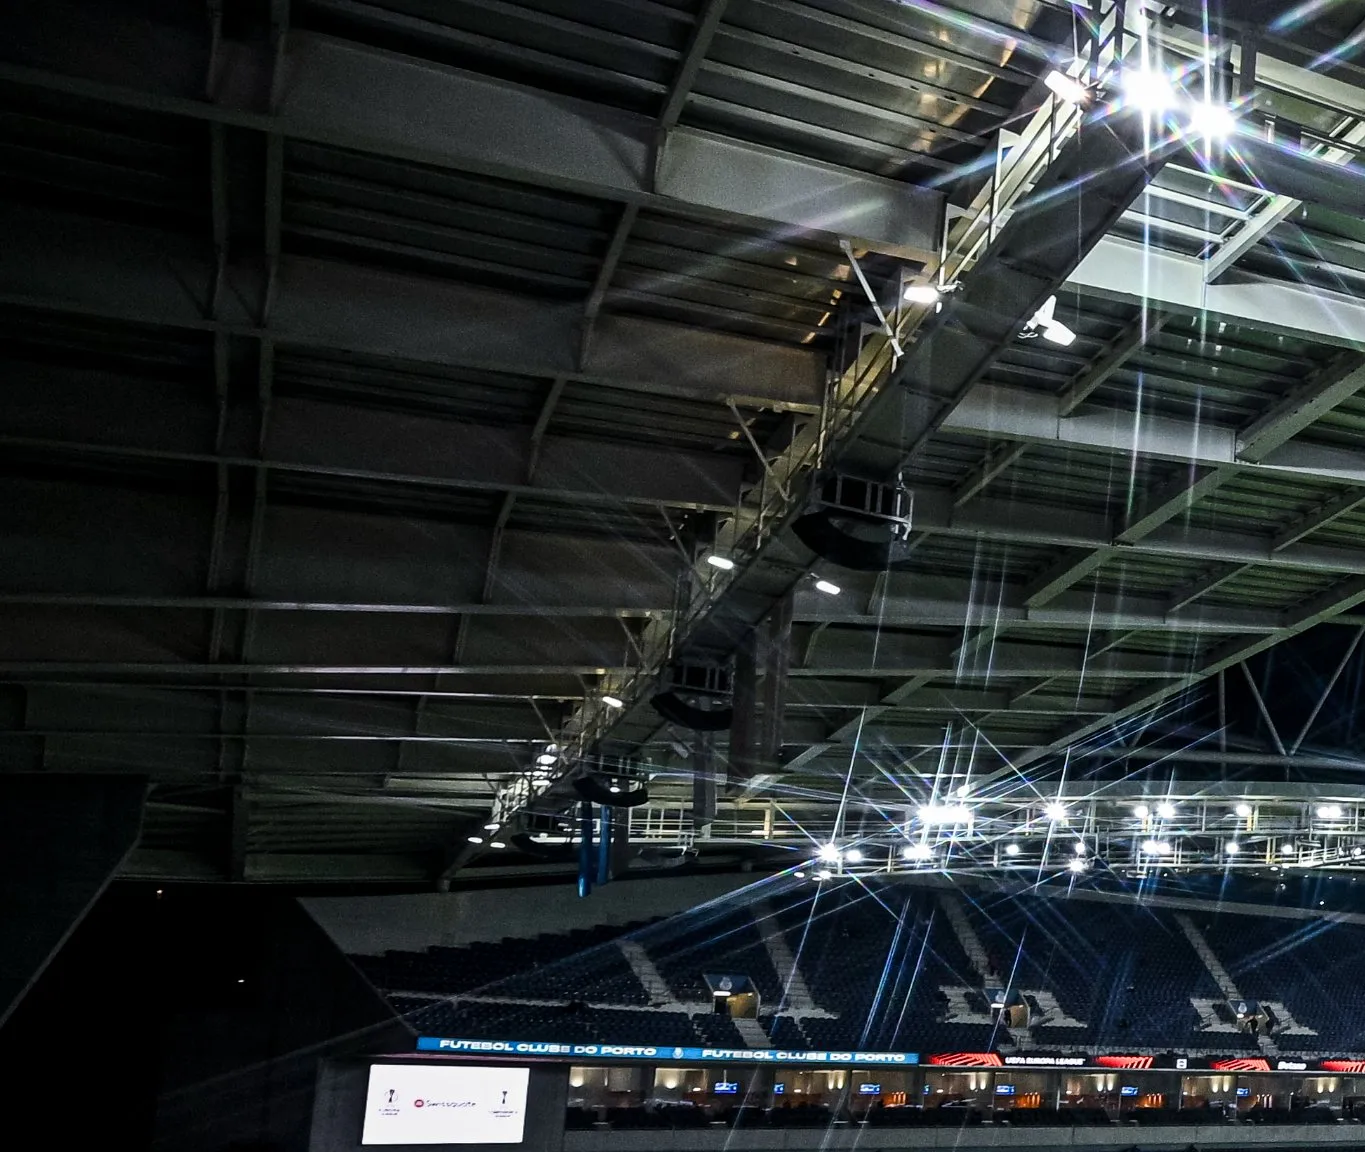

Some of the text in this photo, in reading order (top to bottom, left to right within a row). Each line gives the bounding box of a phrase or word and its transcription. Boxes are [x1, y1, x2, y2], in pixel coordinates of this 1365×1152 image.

[440, 1040, 657, 1056] FUTEBOL CLUBE DO PORTO
[702, 1049, 906, 1062] FUTEBOL CLUBE DO PORTO
